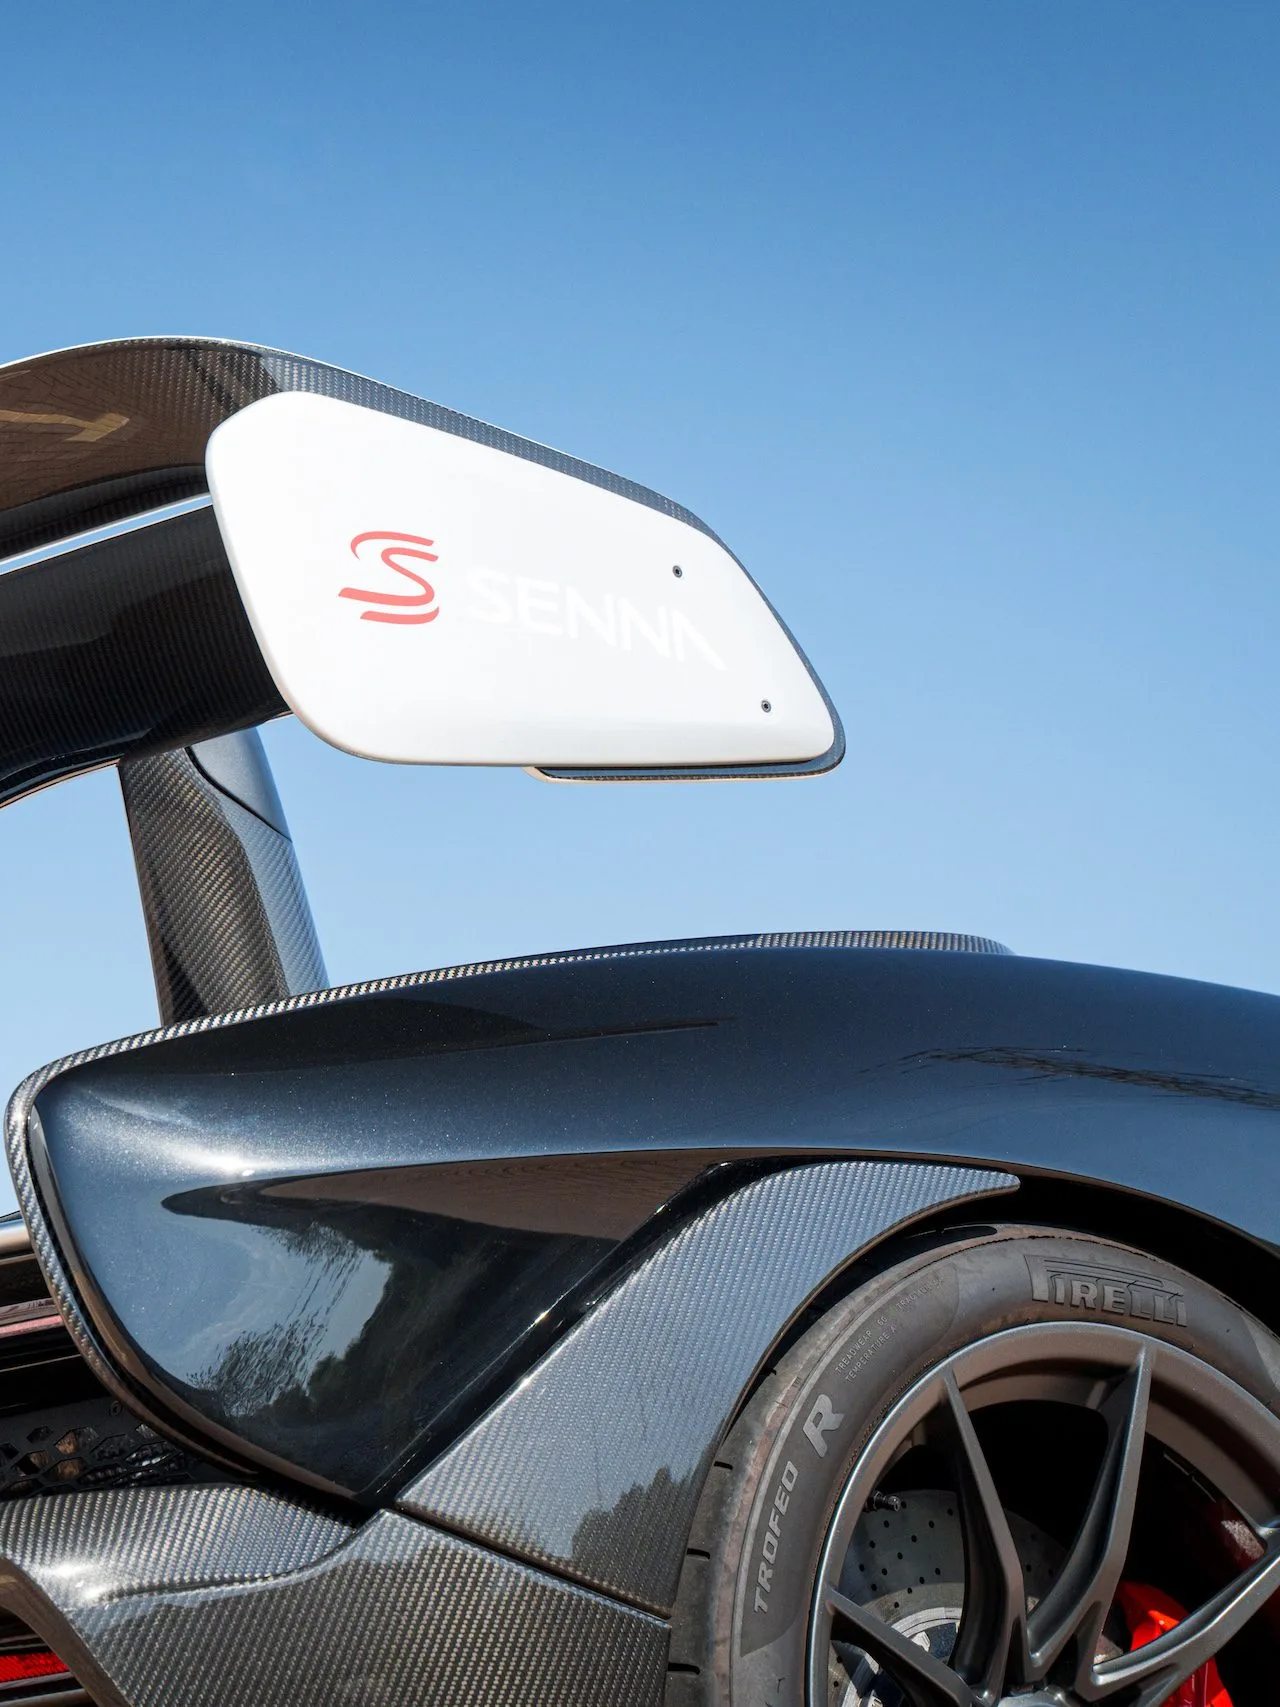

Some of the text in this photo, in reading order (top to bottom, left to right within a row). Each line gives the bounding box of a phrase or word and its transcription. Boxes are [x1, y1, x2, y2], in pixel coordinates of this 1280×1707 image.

[466, 565, 728, 671] SENNA
[1023, 1254, 1187, 1327] PIRELLI
[835, 1330, 872, 1375] TREADWEAR
[754, 1393, 845, 1613] TROFEO R
